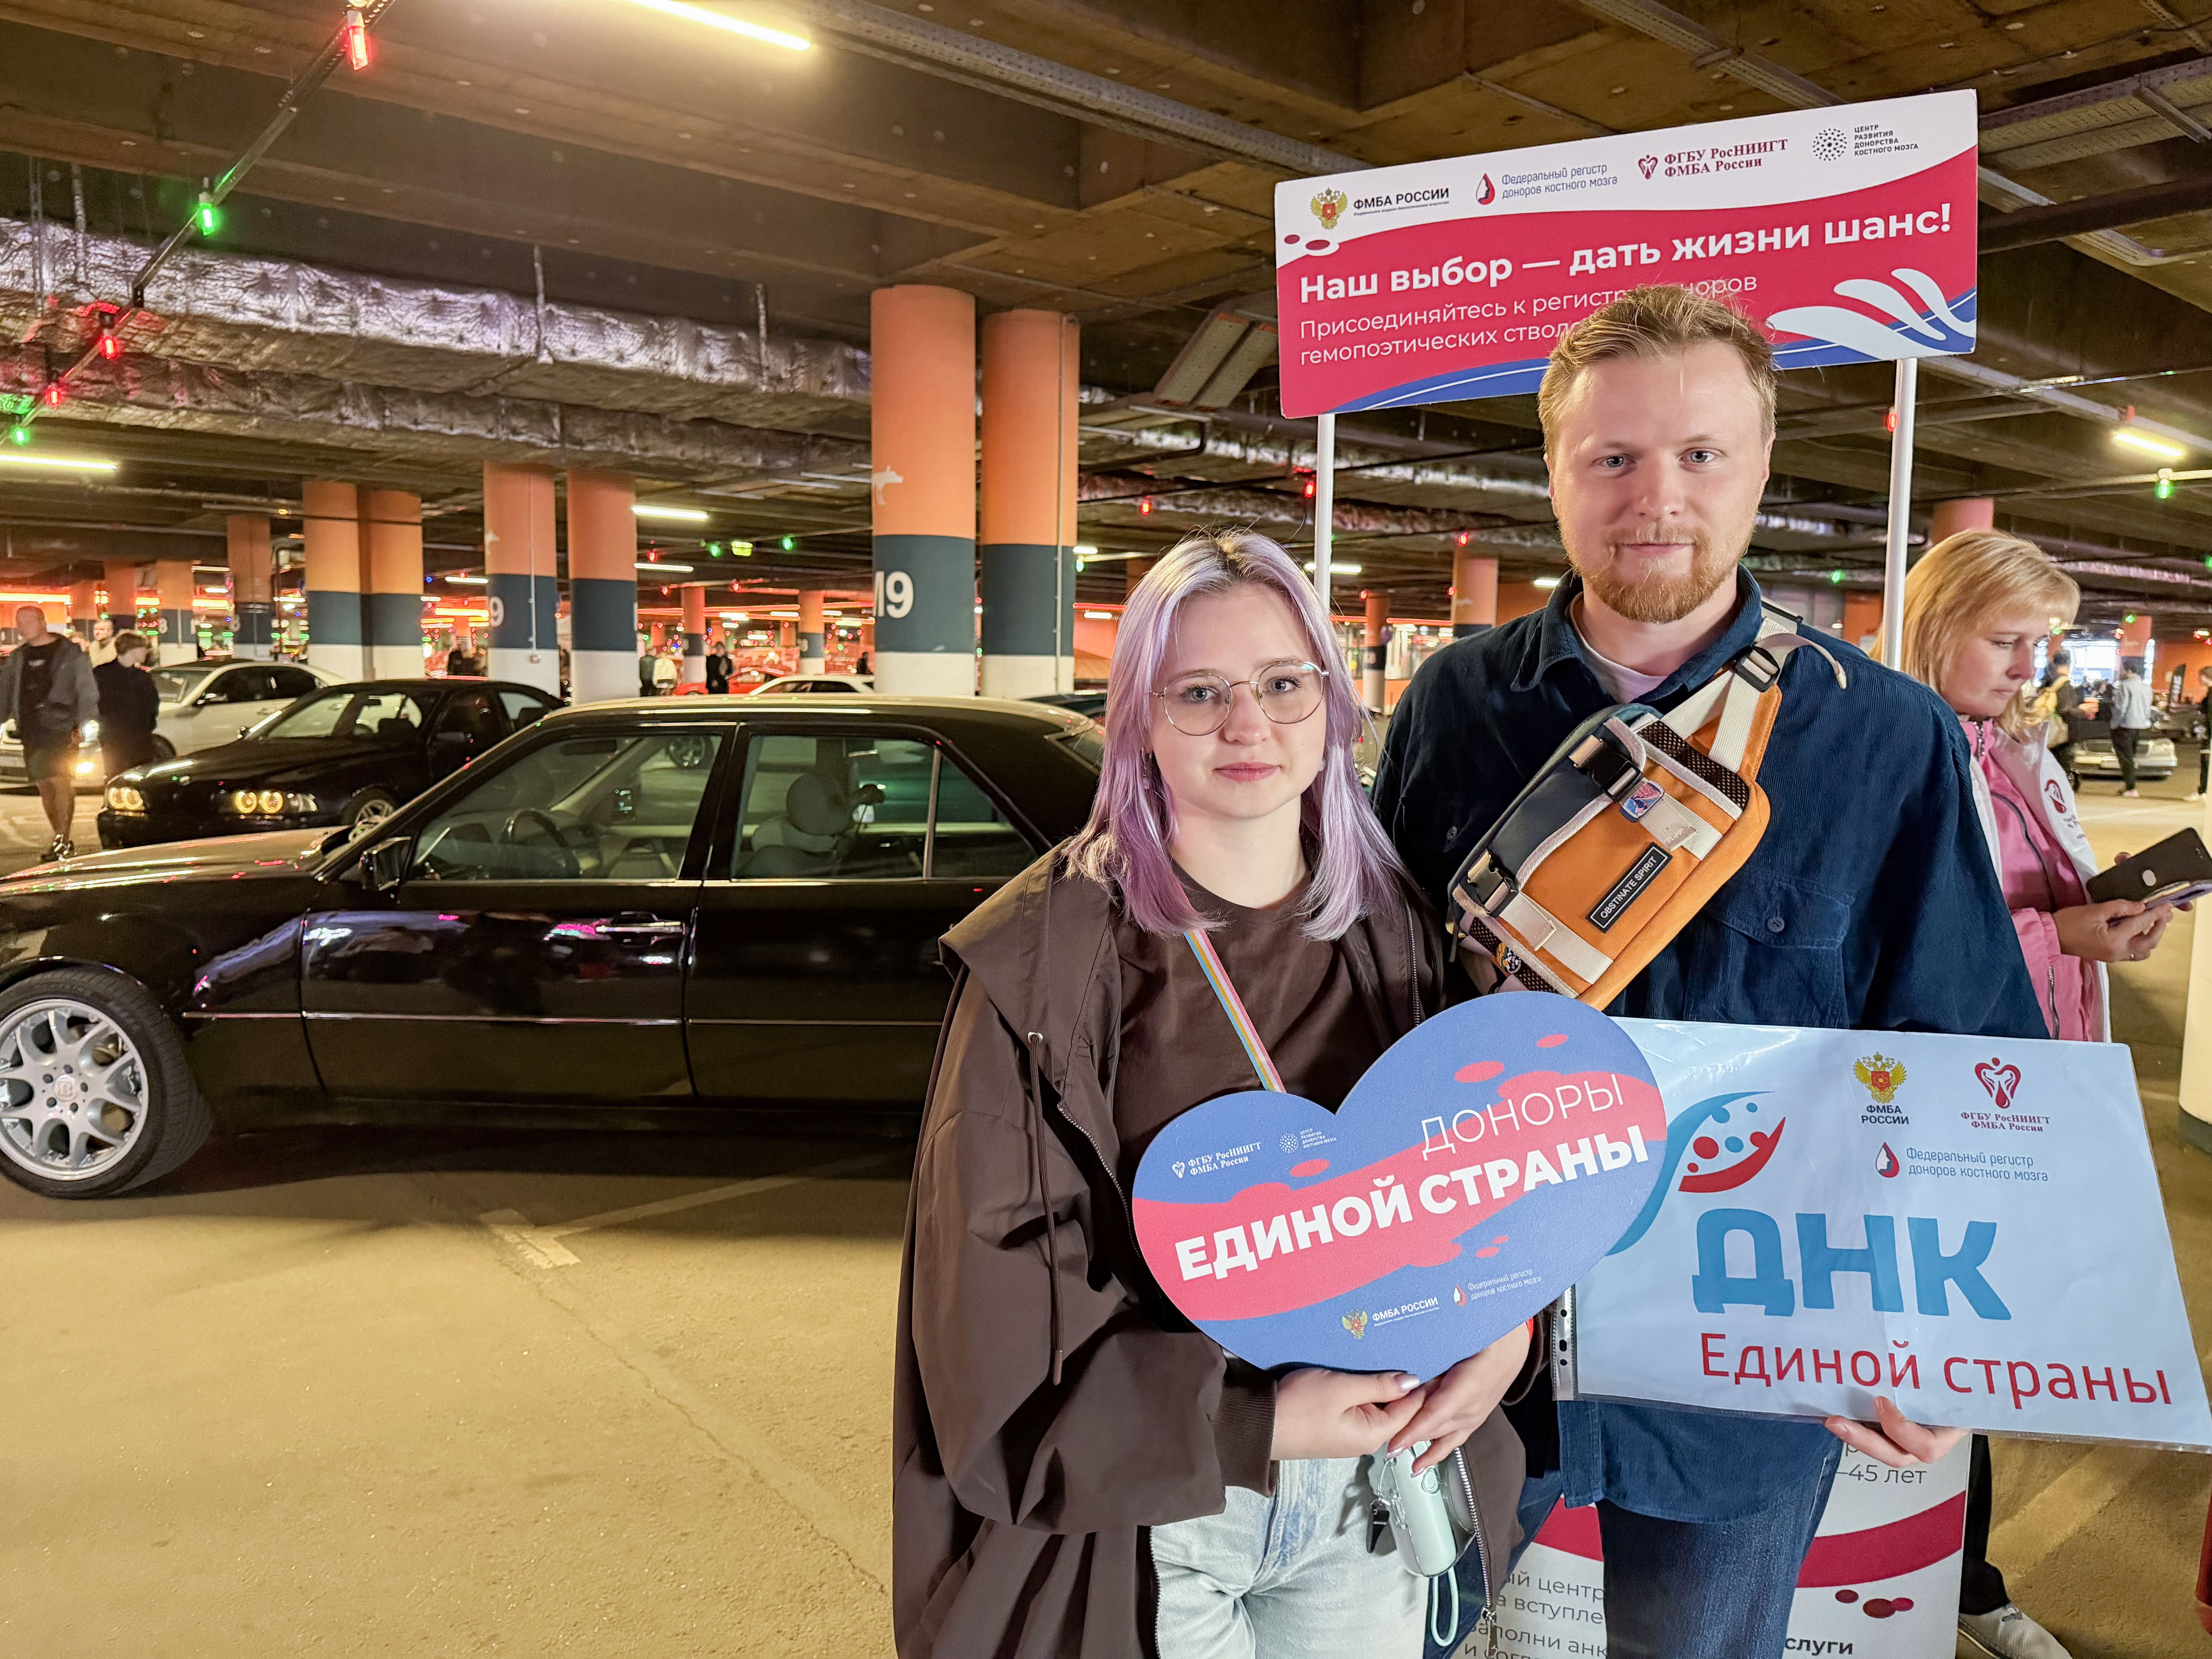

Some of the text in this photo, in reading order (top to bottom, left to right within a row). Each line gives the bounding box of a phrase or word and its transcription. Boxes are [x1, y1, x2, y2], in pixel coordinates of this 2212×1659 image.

[1854, 131, 1893, 140] РАЗВИТИЯ
[1855, 125, 1879, 133] ЦЕНТР
[1664, 139, 1788, 165] ФГБУ РосНИИГТ
[1854, 138, 1899, 149] ДОНОРСТВА
[1854, 146, 1892, 156] КОСТНОГО
[1502, 165, 1607, 185] Федеральный регистр
[1665, 158, 1762, 177] ФМБА России
[1502, 176, 1618, 199] доноров костного мозга
[1353, 195, 1392, 210] ФМБА
[1396, 188, 1449, 204] РОССИИ
[1301, 273, 1378, 303] Наш
[1391, 256, 1512, 292] выбор
[1569, 242, 1661, 276] дать
[1671, 224, 1809, 261] жизни
[1824, 203, 1951, 244] шанс!
[1300, 303, 1506, 341] Присоединяйтесь
[1514, 300, 1526, 314] к
[1301, 330, 1498, 365] гемопоэтических
[1600, 856, 1657, 919] OBSTINATE SPIRIT
[1420, 1073, 1624, 1161] ДОНОРЫ
[1861, 1115, 1909, 1124] РОССИИ
[1866, 1104, 1902, 1114] ФМБА
[1961, 1112, 2050, 1124] ФГБУ РосНИИГТ
[1971, 1121, 2044, 1132] ФМБА России
[1188, 1142, 1261, 1167] ФГБУ РосНИИГТ
[1190, 1156, 1249, 1175] ФМБА России
[1906, 1147, 2033, 1169] Федеральный регистр
[1909, 1165, 2048, 1182] доноров костного мозга
[1175, 1125, 1649, 1281] ЕДИНОЙ СТРАНЫ
[1692, 1208, 2012, 1320] ДНК
[1467, 1269, 1533, 1291] Федеральный регистр
[1471, 1276, 1542, 1301] доноров костного мозга
[1372, 1307, 1400, 1322] ФМБА
[1401, 1297, 1439, 1314] РОССИИ
[1700, 1333, 2172, 1409] Единой страны
[1884, 1470, 1927, 1484] лет
[1539, 1578, 1604, 1602] центр
[1515, 1597, 1603, 1624] вступле
[1472, 1623, 1560, 1650] аполни
[1785, 1638, 1853, 1656] слуги
